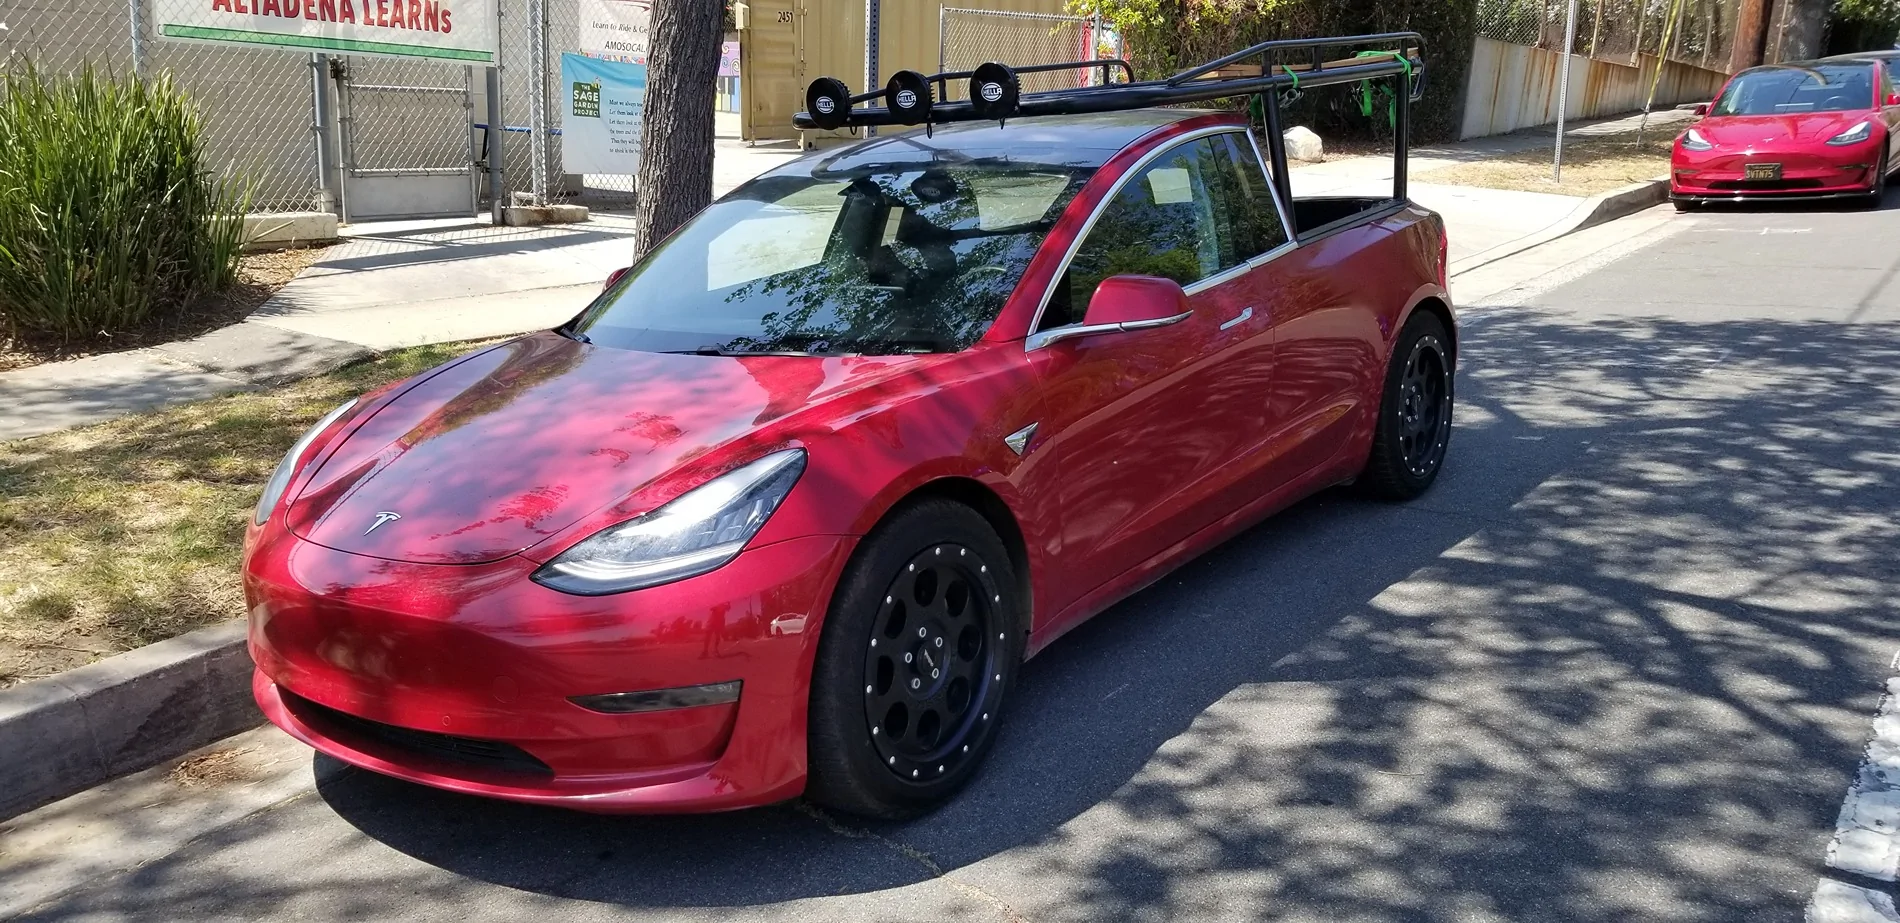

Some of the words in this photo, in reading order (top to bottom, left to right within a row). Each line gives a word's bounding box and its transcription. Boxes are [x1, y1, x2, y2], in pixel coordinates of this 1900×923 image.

[592, 20, 609, 30] Learn
[618, 23, 631, 33] Ride
[633, 25, 638, 33] &
[639, 25, 648, 34] Ge
[573, 90, 599, 102] SAGE
[573, 108, 599, 116] PROJECT
